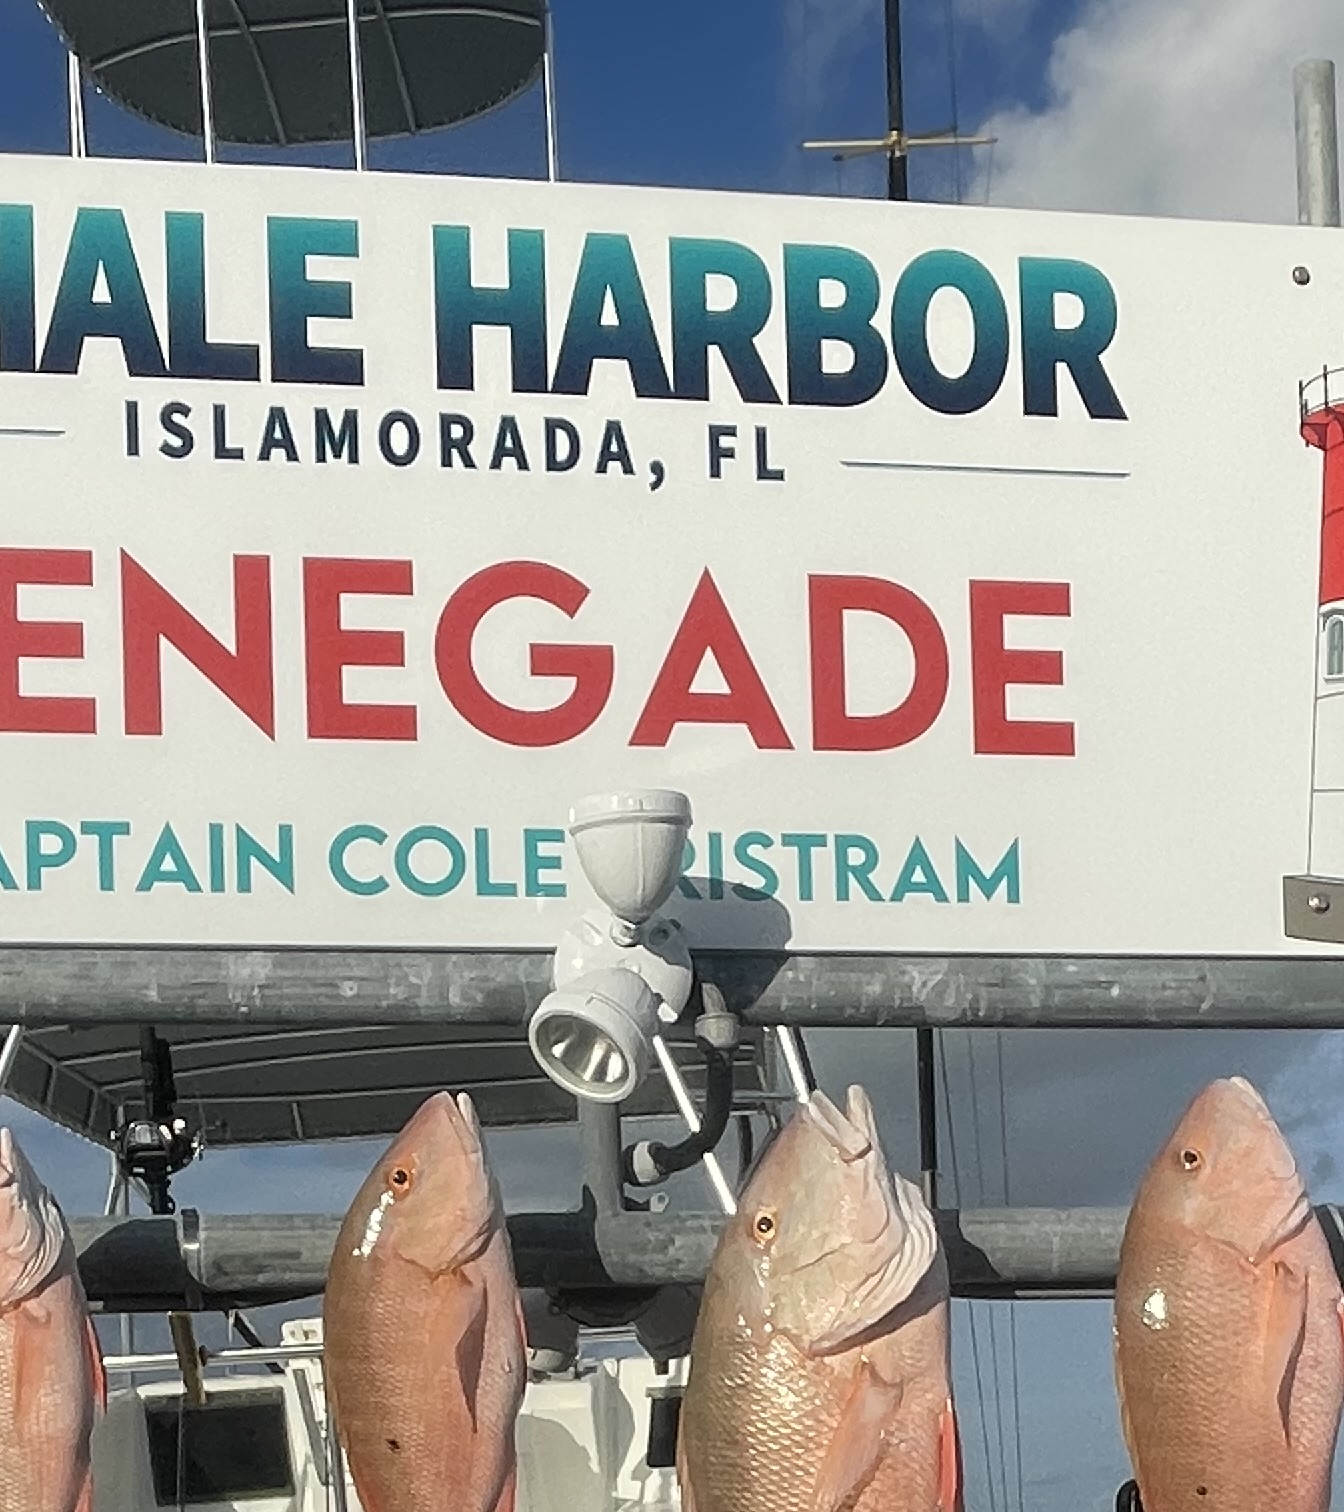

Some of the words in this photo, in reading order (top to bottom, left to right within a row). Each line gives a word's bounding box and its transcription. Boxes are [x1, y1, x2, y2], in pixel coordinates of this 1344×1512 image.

[432, 224, 1128, 421] HARBOR
[125, 400, 666, 492] ISLAMORADA,
[709, 424, 785, 481] FL
[328, 824, 567, 897] COLE
